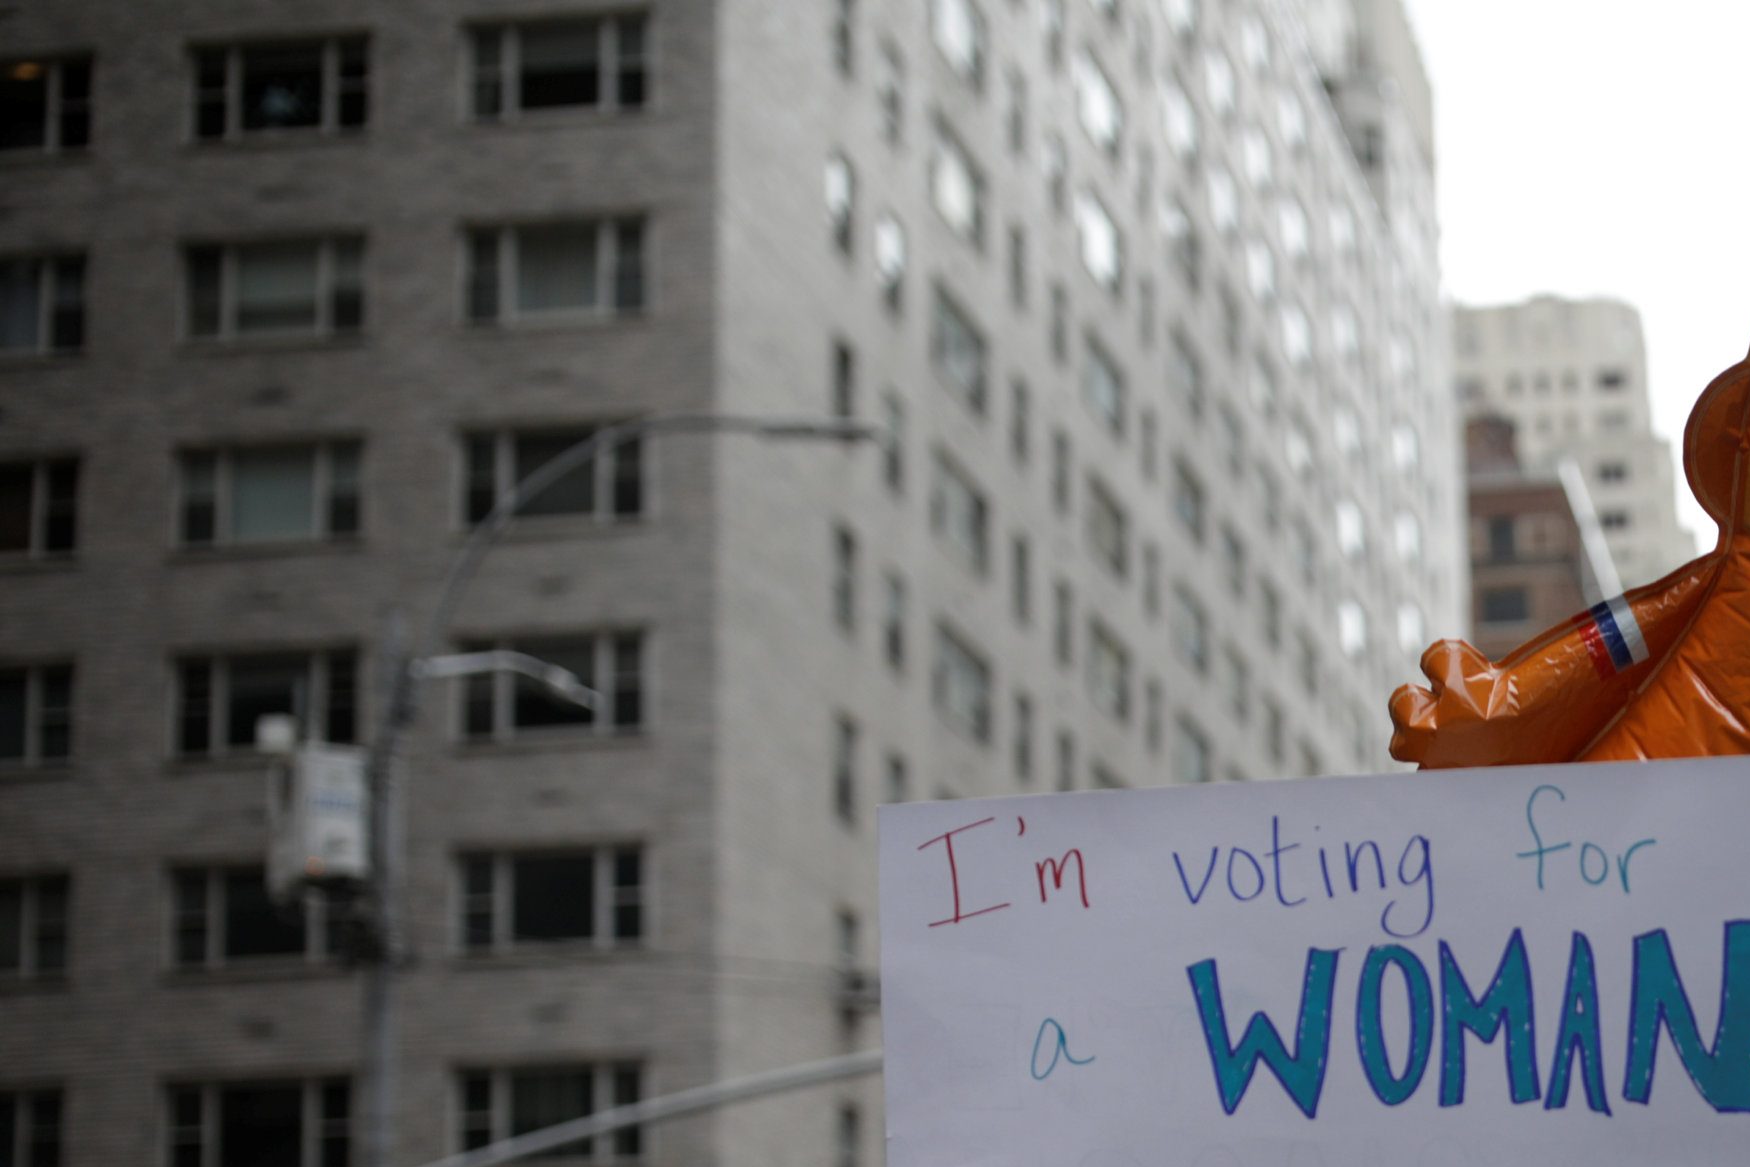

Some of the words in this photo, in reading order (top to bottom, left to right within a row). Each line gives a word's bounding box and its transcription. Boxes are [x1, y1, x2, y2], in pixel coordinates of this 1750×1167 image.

[917, 814, 1090, 928] I'm
[1172, 815, 1436, 938] voting
[1517, 785, 1657, 894] for
[1030, 1018, 1095, 1080] a
